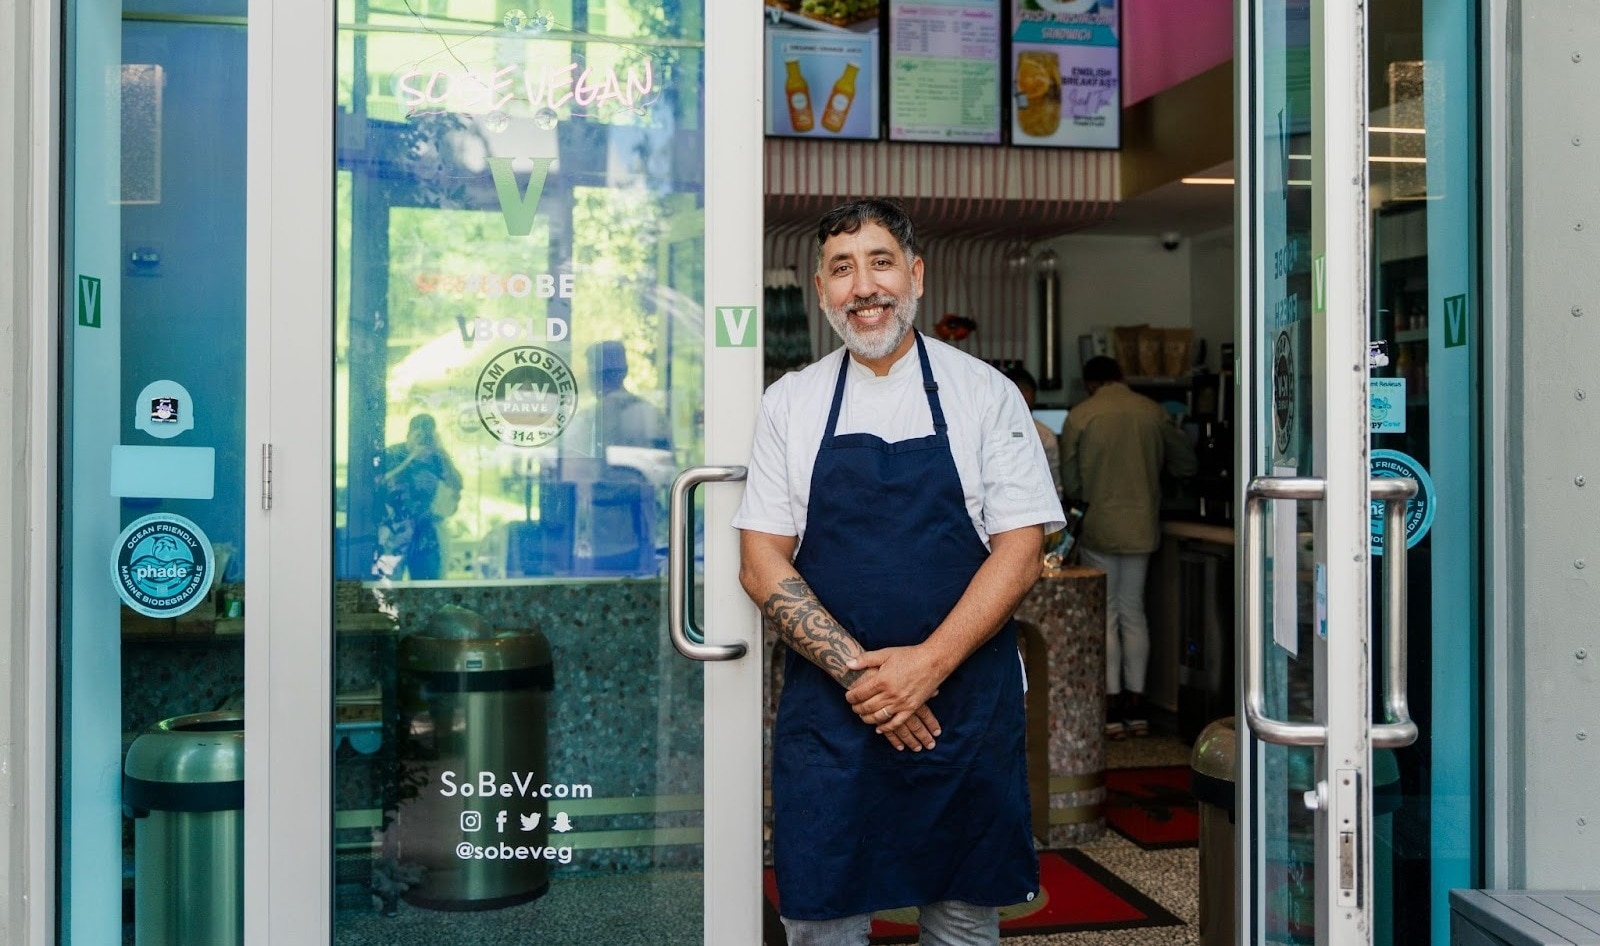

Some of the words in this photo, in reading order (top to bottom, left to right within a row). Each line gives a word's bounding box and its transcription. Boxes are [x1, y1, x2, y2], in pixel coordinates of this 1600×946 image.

[523, 56, 652, 109] VEGAN
[484, 157, 558, 236] V
[81, 278, 99, 324] V
[475, 317, 568, 342] BOLD
[718, 308, 754, 346] V
[1446, 297, 1463, 343] V
[514, 350, 573, 407] KOSHER
[503, 403, 548, 413] PARVE
[1375, 461, 1416, 481] FRIENDL
[127, 525, 155, 549] OCEAN
[156, 524, 198, 548] FRIENDLY
[121, 565, 144, 599] MARINE
[142, 565, 203, 606] BIODEGRADABLE
[137, 564, 187, 581] phade
[439, 770, 593, 798] SoBeV.com
[456, 842, 572, 864] @sobeveg
